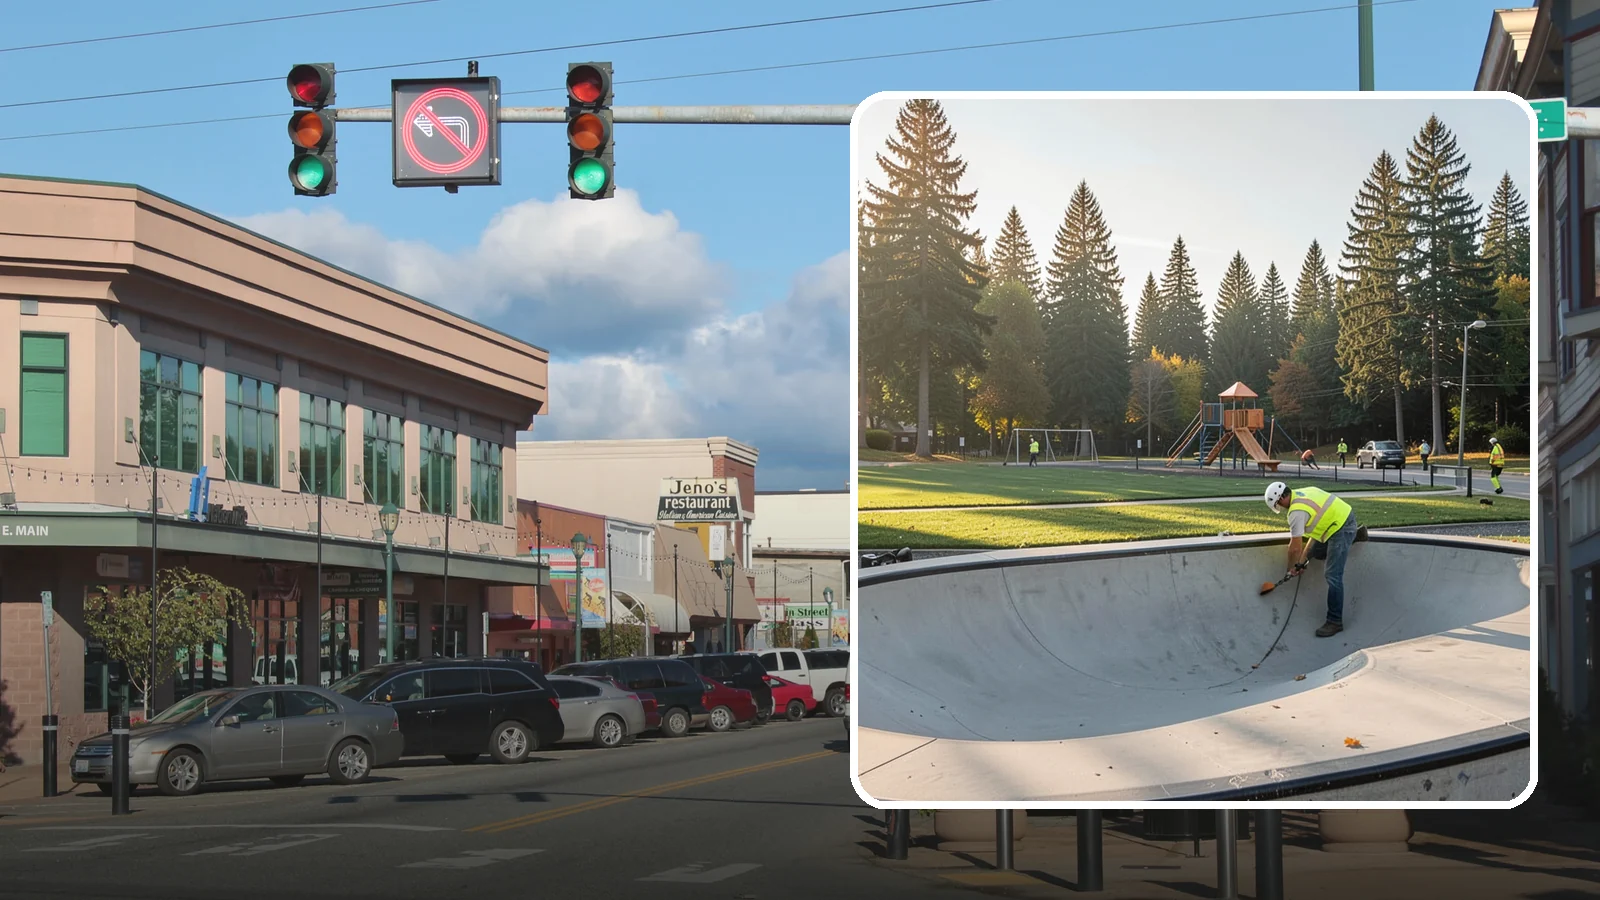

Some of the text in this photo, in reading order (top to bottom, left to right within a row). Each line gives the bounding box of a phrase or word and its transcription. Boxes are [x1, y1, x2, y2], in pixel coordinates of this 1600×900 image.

[669, 480, 727, 494] Jeno's
[665, 496, 731, 509] restaurant
[658, 510, 681, 519] Italian
[686, 510, 714, 519] American
[715, 509, 737, 519] Cuisine
[2, 525, 49, 536] E. MAIN
[797, 607, 829, 617] Street
[791, 619, 824, 627] lass
